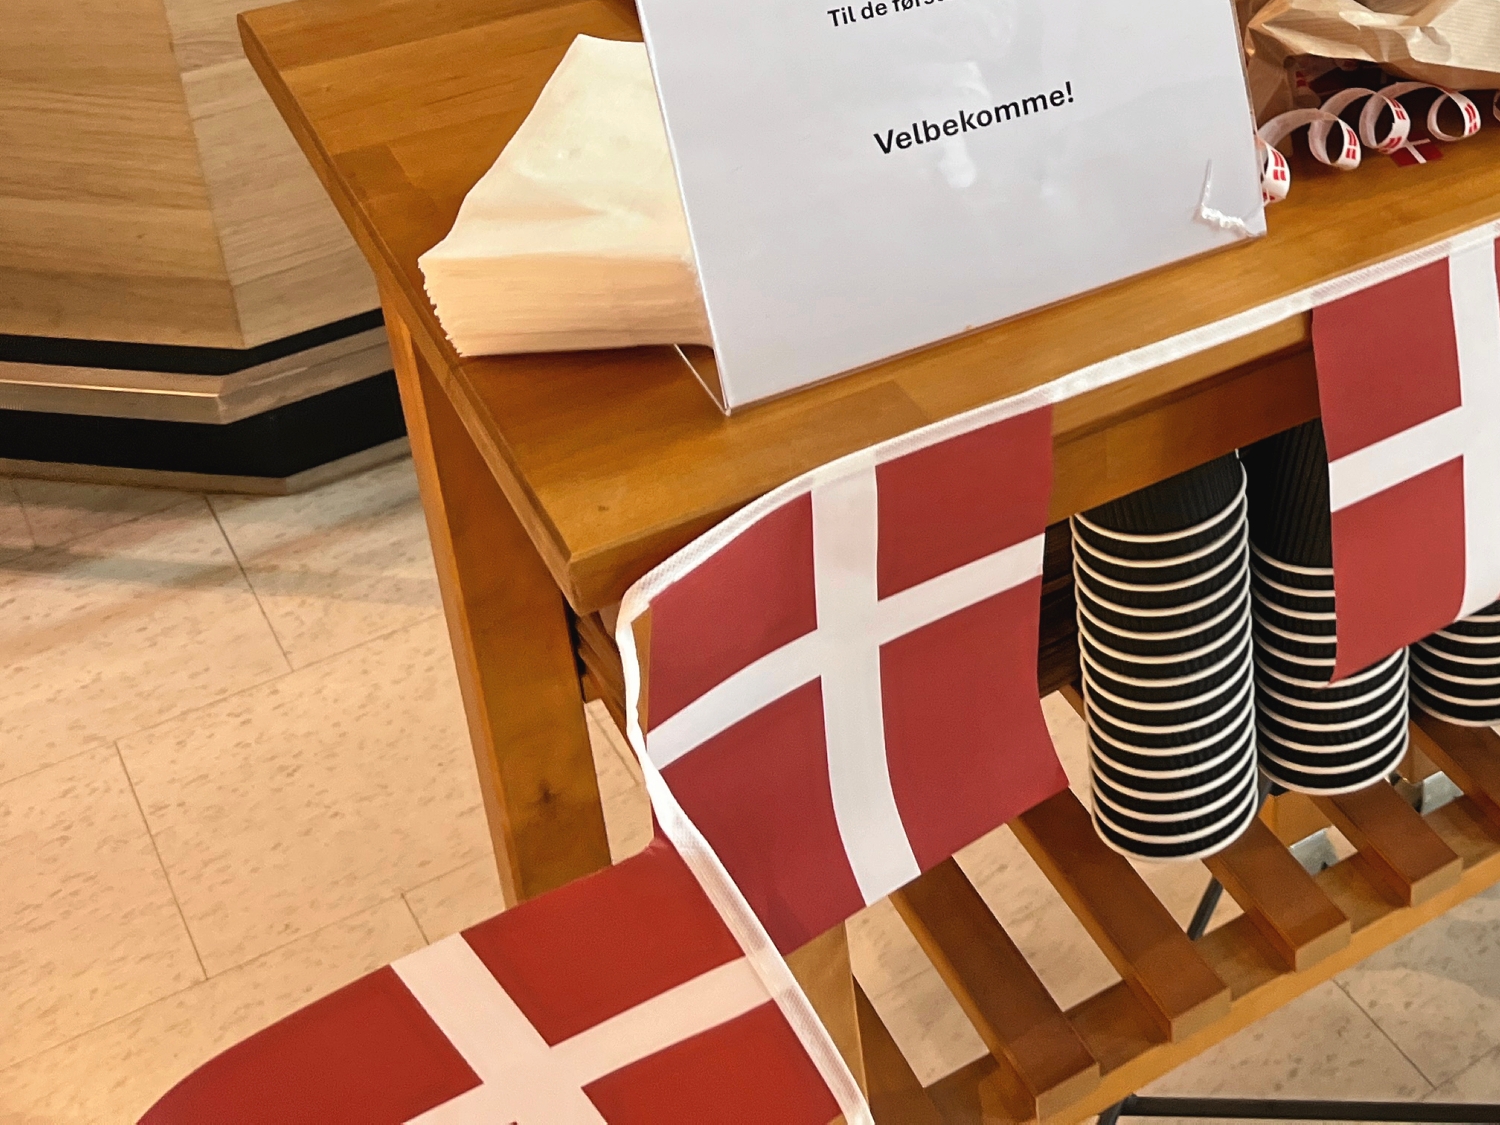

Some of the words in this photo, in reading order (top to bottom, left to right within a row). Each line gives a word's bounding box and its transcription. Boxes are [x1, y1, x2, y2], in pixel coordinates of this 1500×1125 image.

[827, 5, 857, 27] Til
[861, 0, 888, 21] de
[873, 80, 1076, 155] Velbekomme!
